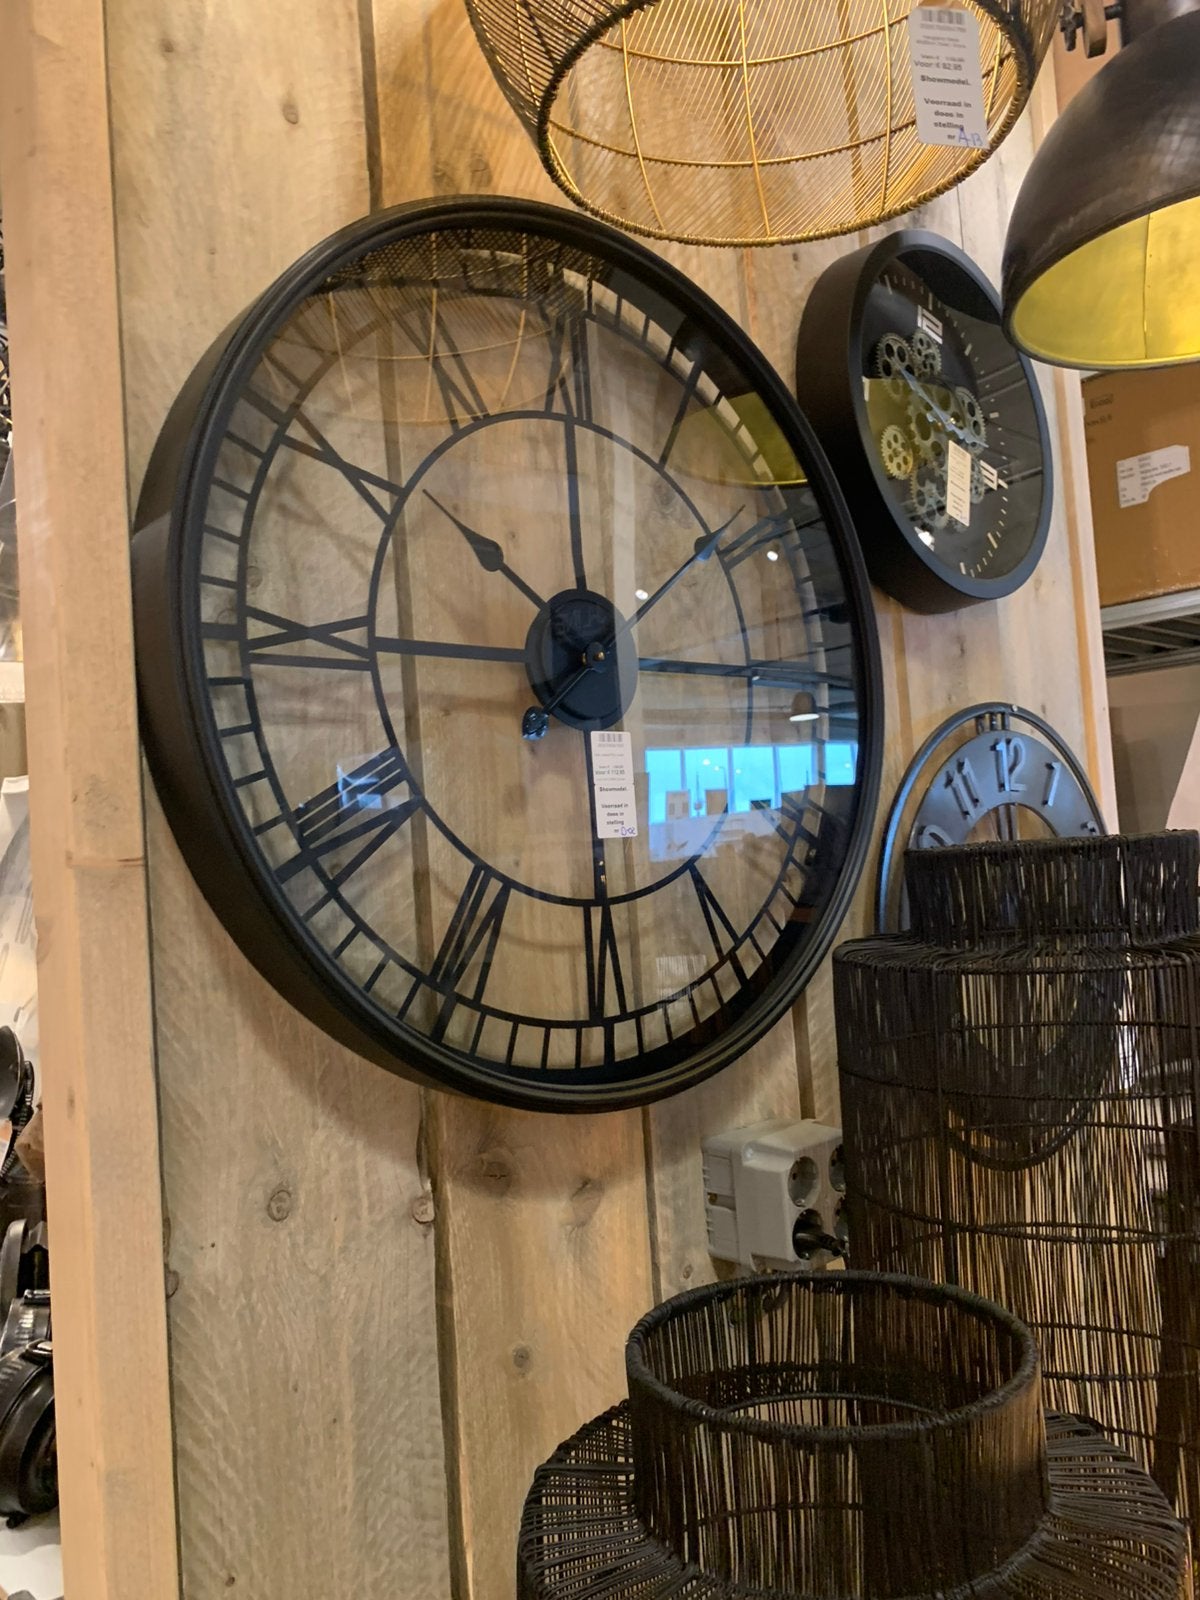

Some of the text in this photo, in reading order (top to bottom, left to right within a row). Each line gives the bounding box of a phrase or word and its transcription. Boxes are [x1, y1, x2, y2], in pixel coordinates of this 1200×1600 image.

[923, 98, 962, 107] Voorraad
[934, 110, 965, 119] doos in
[933, 121, 964, 132] stelling
[993, 737, 1027, 793] 12
